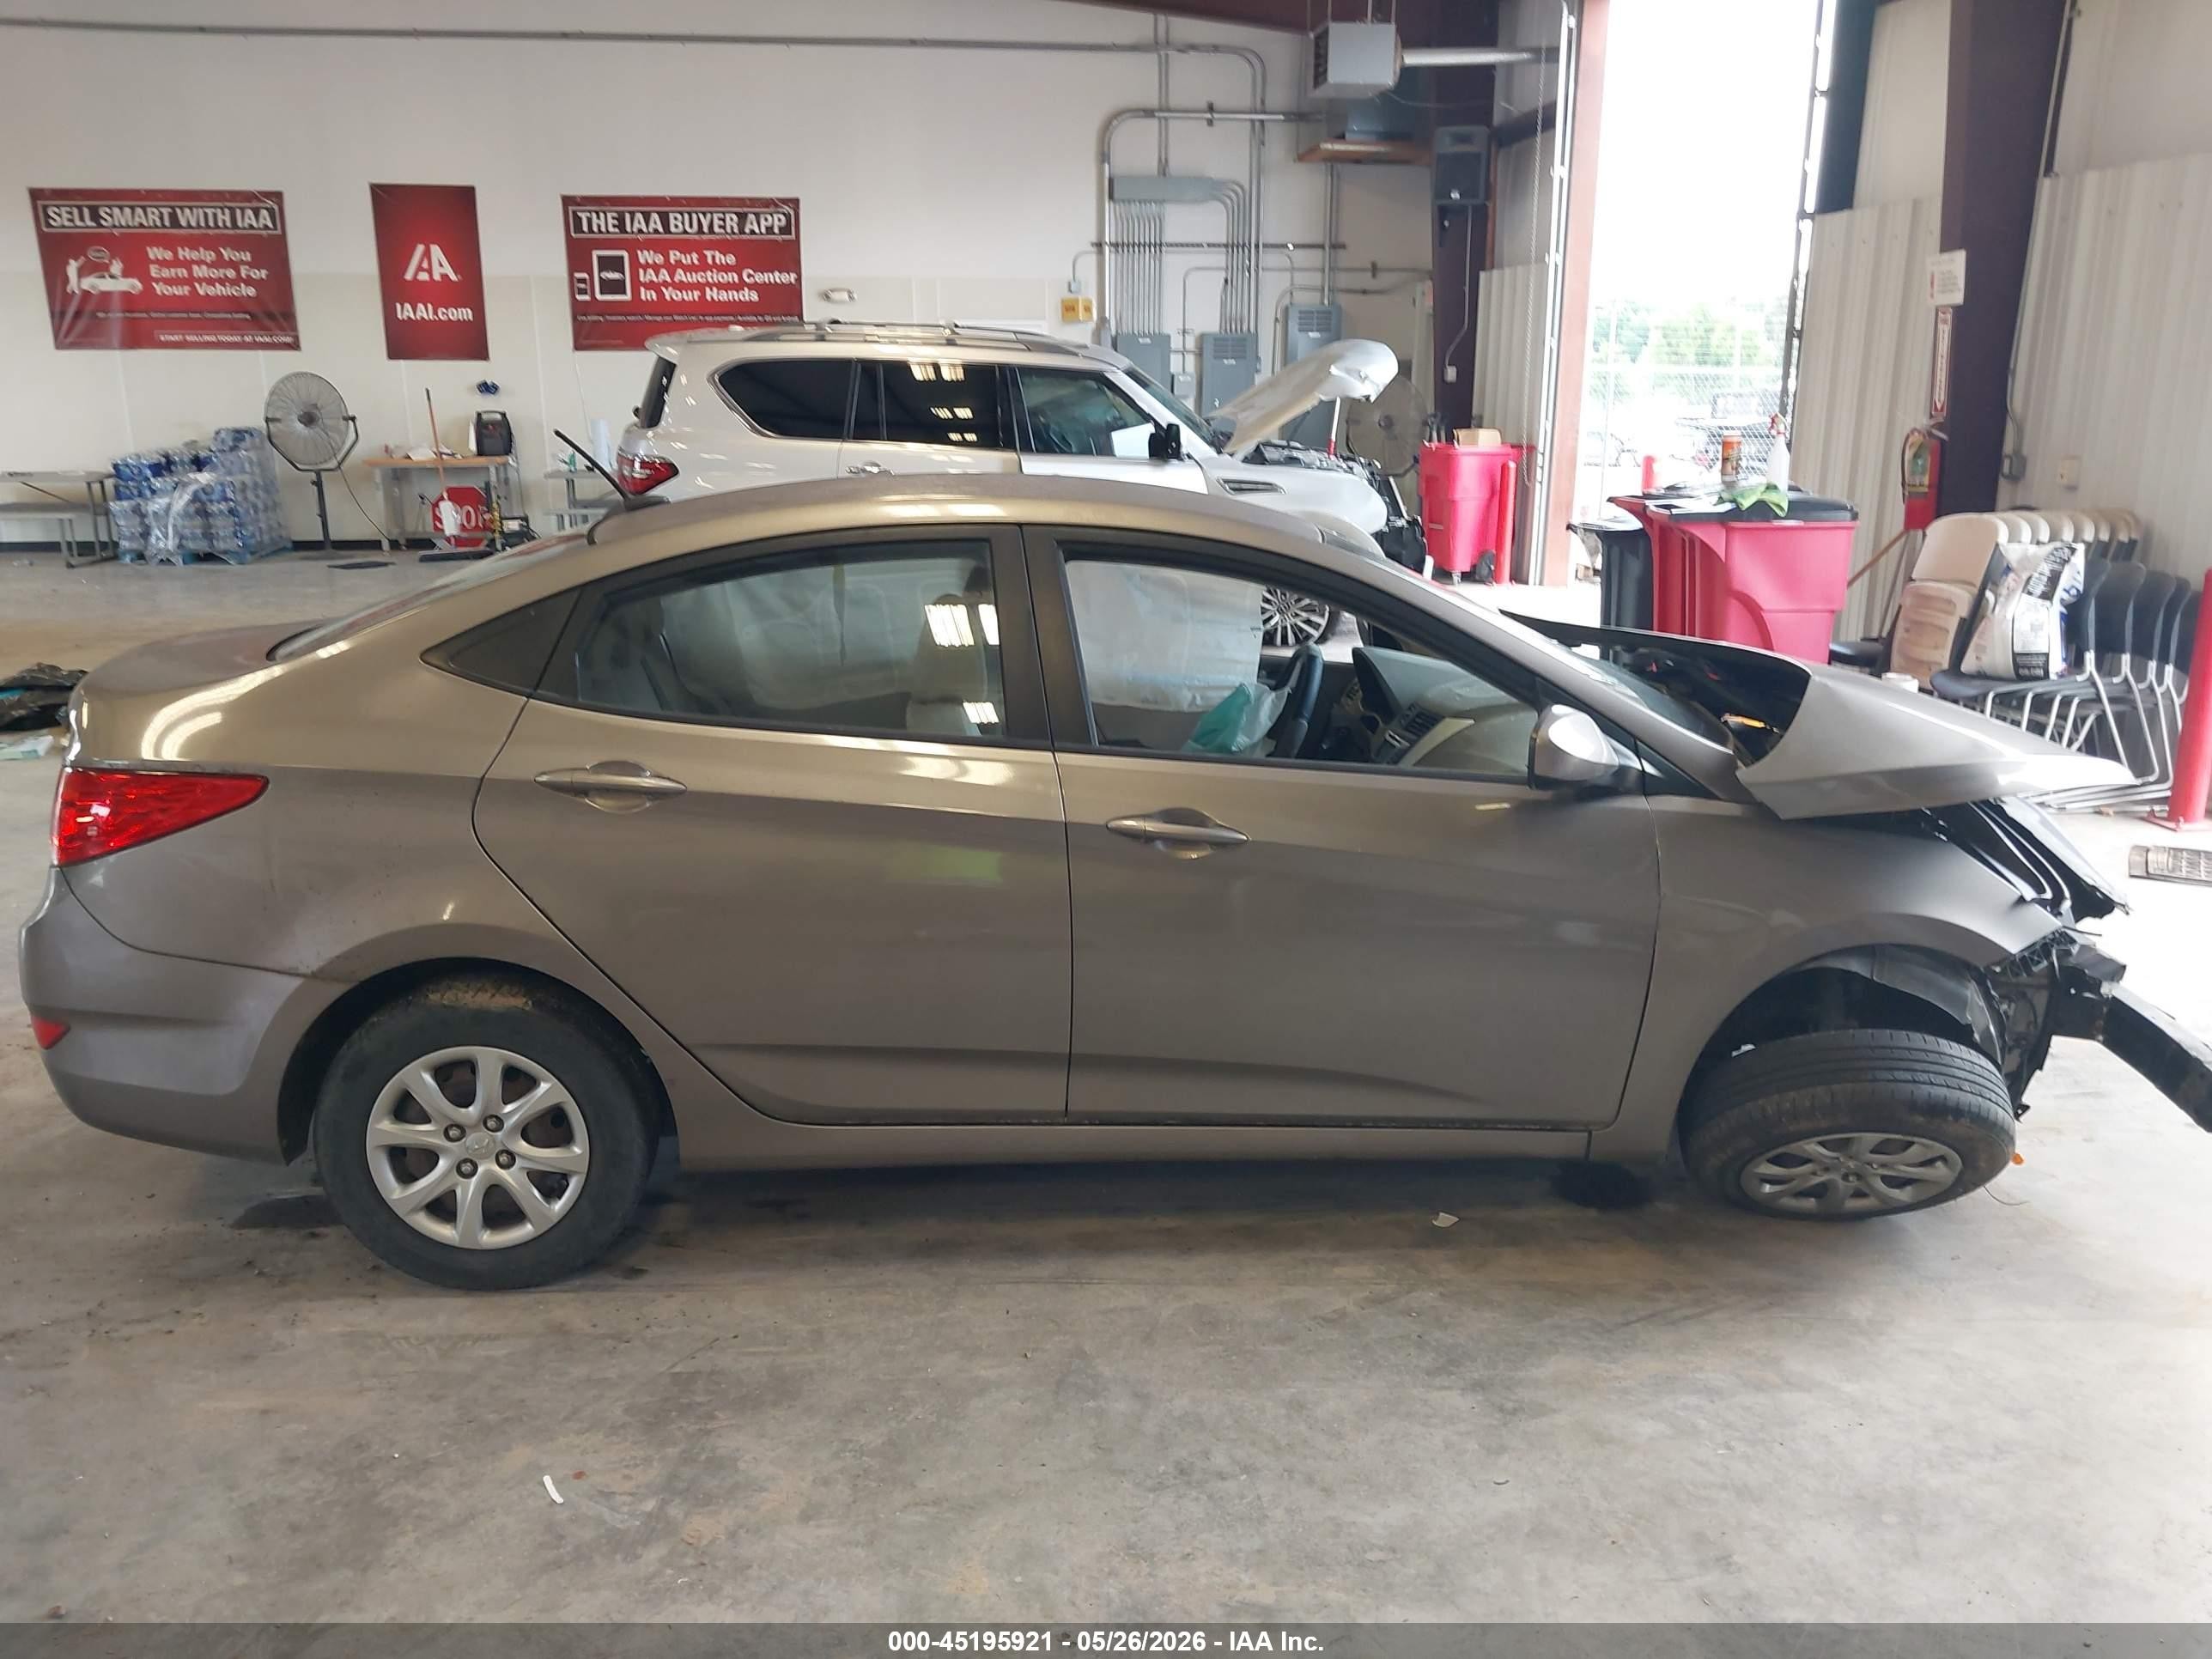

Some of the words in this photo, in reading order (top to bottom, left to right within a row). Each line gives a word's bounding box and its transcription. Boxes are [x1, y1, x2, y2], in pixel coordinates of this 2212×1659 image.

[47, 206, 96, 227] SELL
[99, 206, 173, 228] SMART
[175, 208, 230, 228] WITH
[235, 209, 274, 228] IAA
[576, 211, 620, 233] THE
[624, 212, 665, 234] IAA
[668, 213, 738, 234] BUYER
[744, 214, 787, 234] APP
[147, 246, 173, 261] We
[177, 246, 216, 264] Help
[219, 247, 252, 262] You
[637, 250, 664, 265] We
[669, 250, 699, 265] Put
[703, 250, 737, 265] The
[149, 264, 189, 279] Earn
[191, 264, 236, 279] More
[240, 265, 269, 280] For
[639, 268, 672, 283] IAA
[674, 268, 738, 284] Auction
[742, 268, 799, 284] Center
[151, 282, 191, 296] Your
[194, 282, 257, 297] Vehicle
[639, 287, 658, 301] In
[660, 287, 701, 301] Your
[704, 287, 759, 301] Hands
[396, 302, 473, 321] IAAI.com
